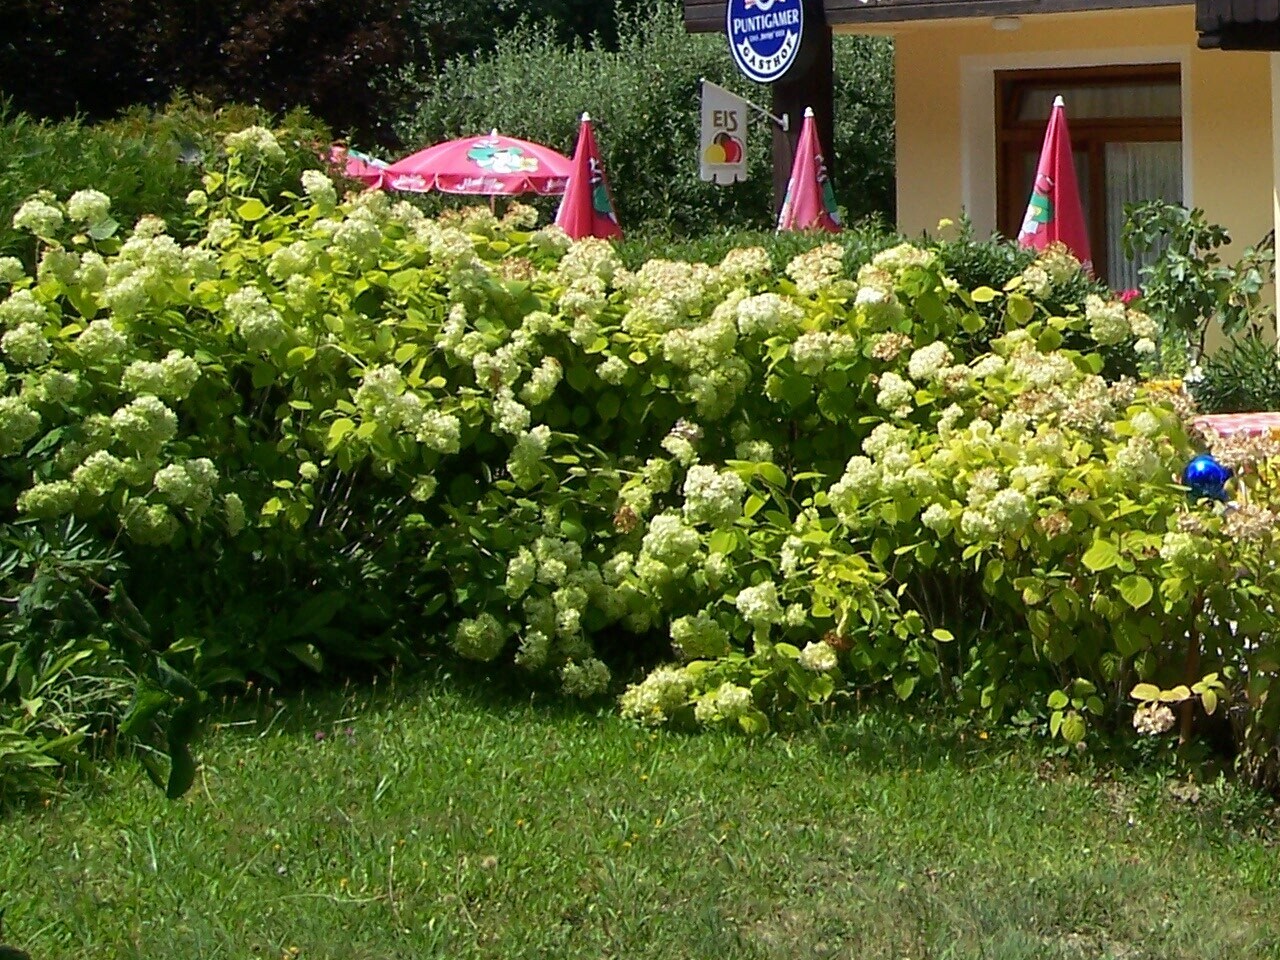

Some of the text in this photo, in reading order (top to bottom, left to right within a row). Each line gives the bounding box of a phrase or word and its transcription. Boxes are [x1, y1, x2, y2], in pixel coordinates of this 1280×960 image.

[734, 9, 799, 34] PUNTIGAMER
[743, 40, 793, 70] GASTHOF
[713, 110, 738, 132] EIS
